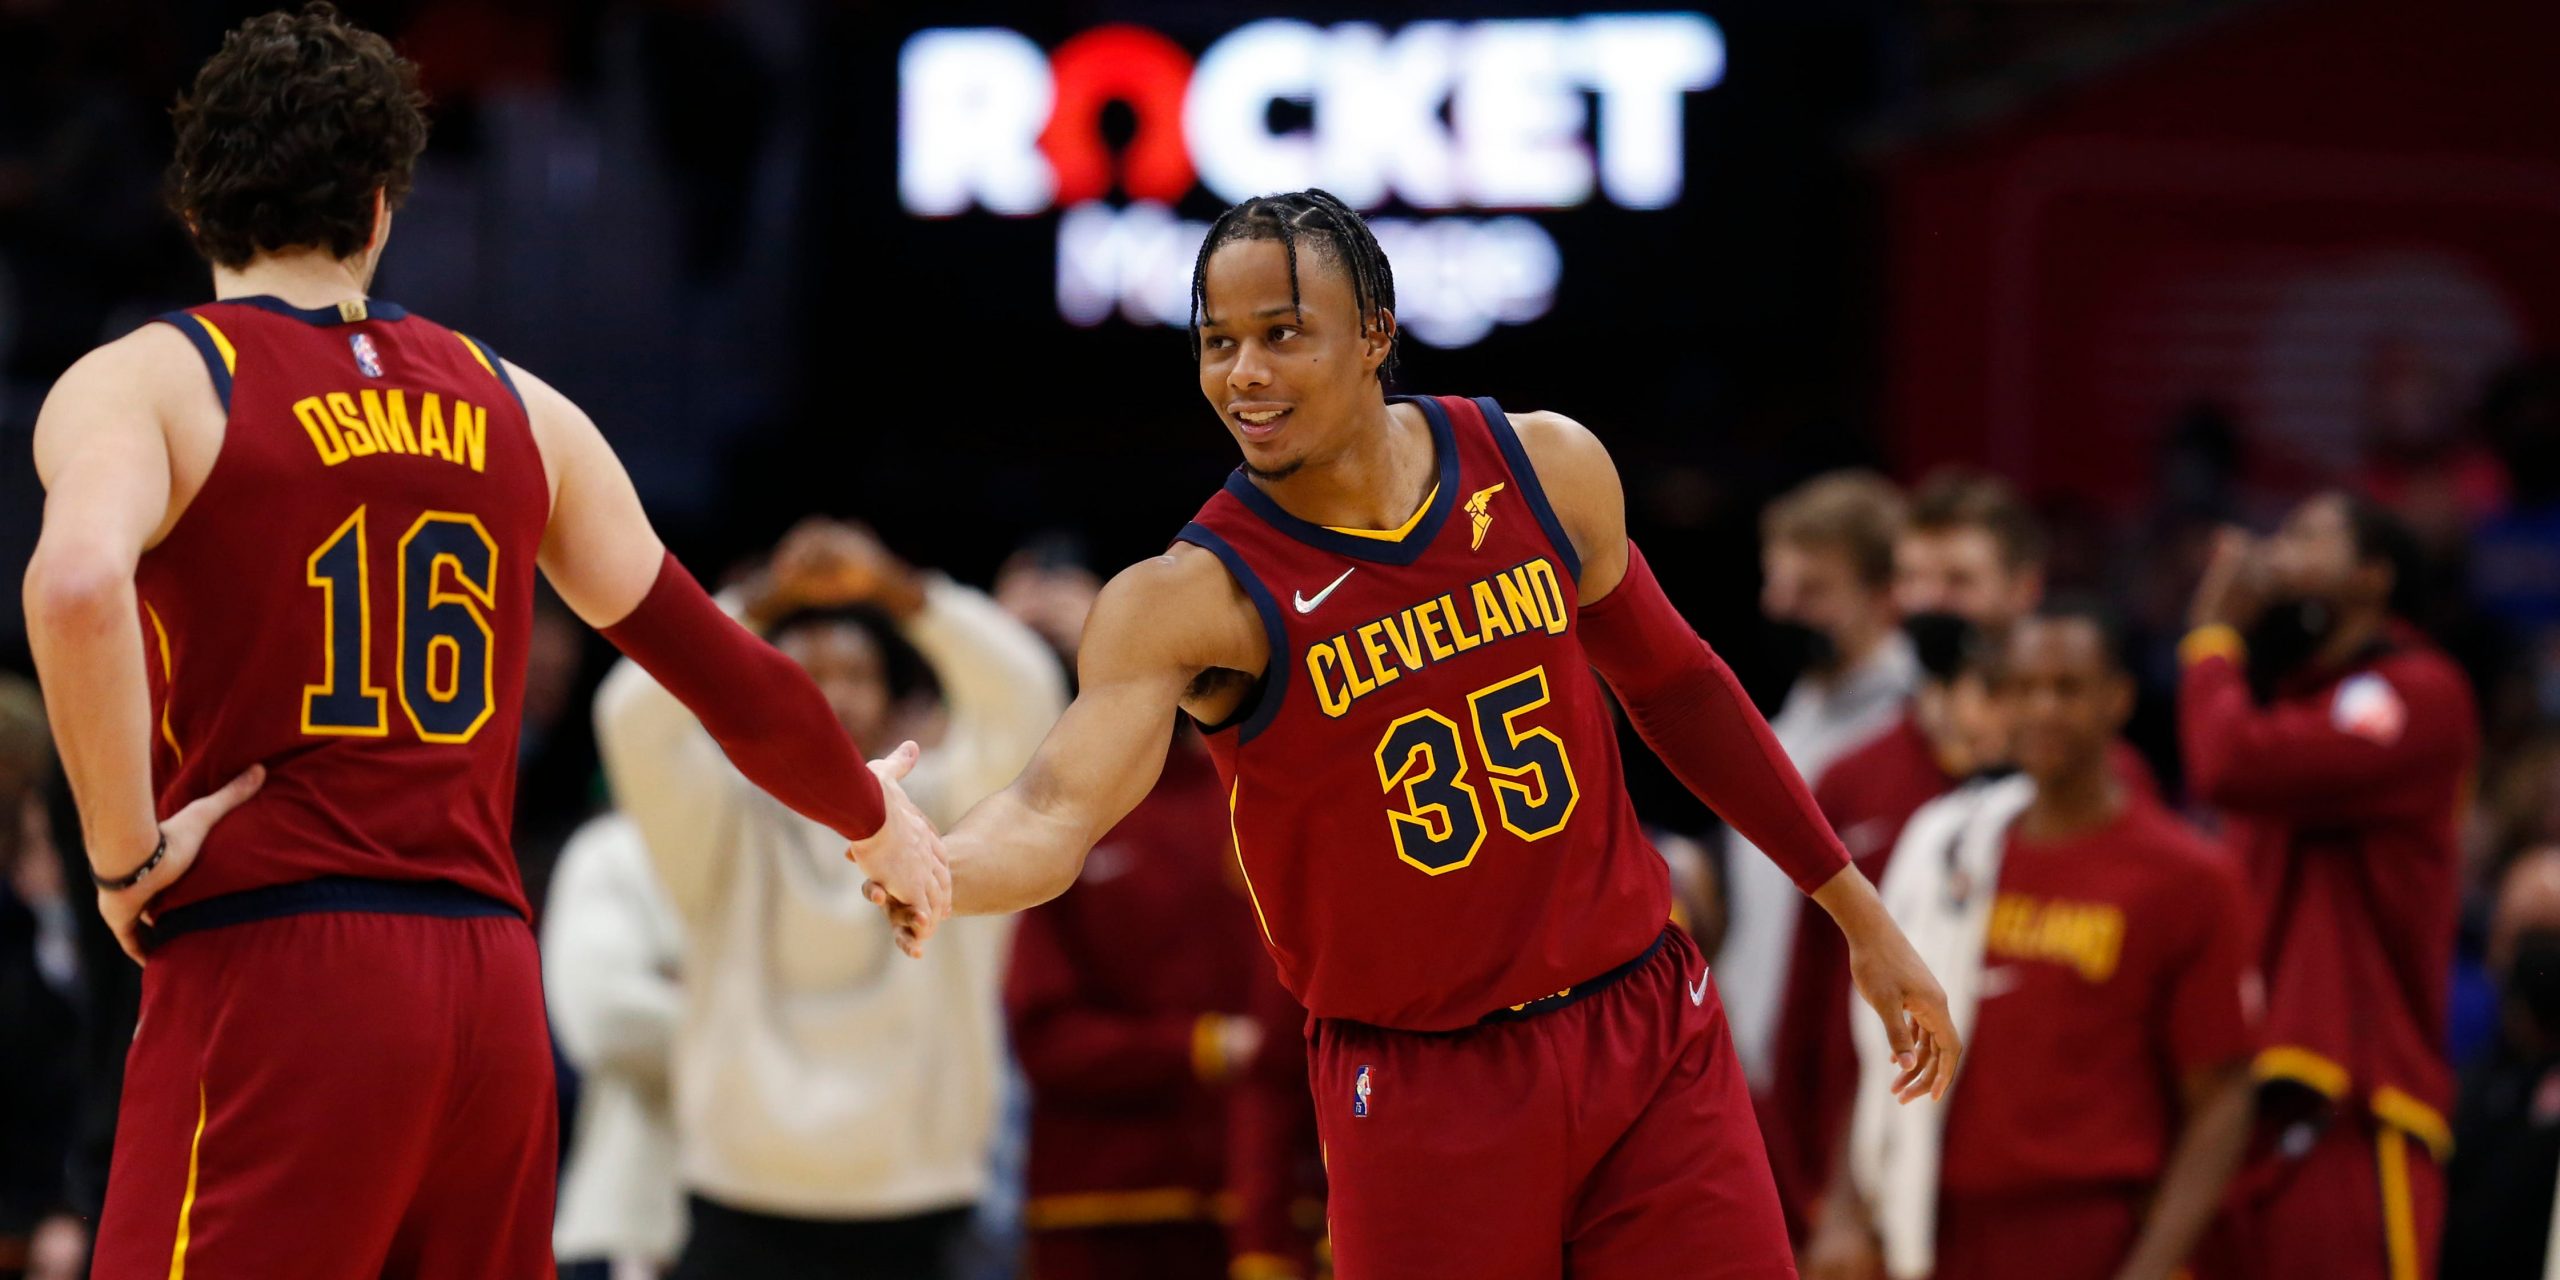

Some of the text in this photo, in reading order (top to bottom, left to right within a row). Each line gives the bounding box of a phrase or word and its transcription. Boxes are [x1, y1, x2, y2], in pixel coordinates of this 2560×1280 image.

[898, 11, 1727, 217] ROCKET
[292, 388, 488, 474] OSMAN
[300, 503, 499, 744] 16
[1304, 556, 1569, 720] CLEVELAND
[1374, 664, 1580, 877] 35
